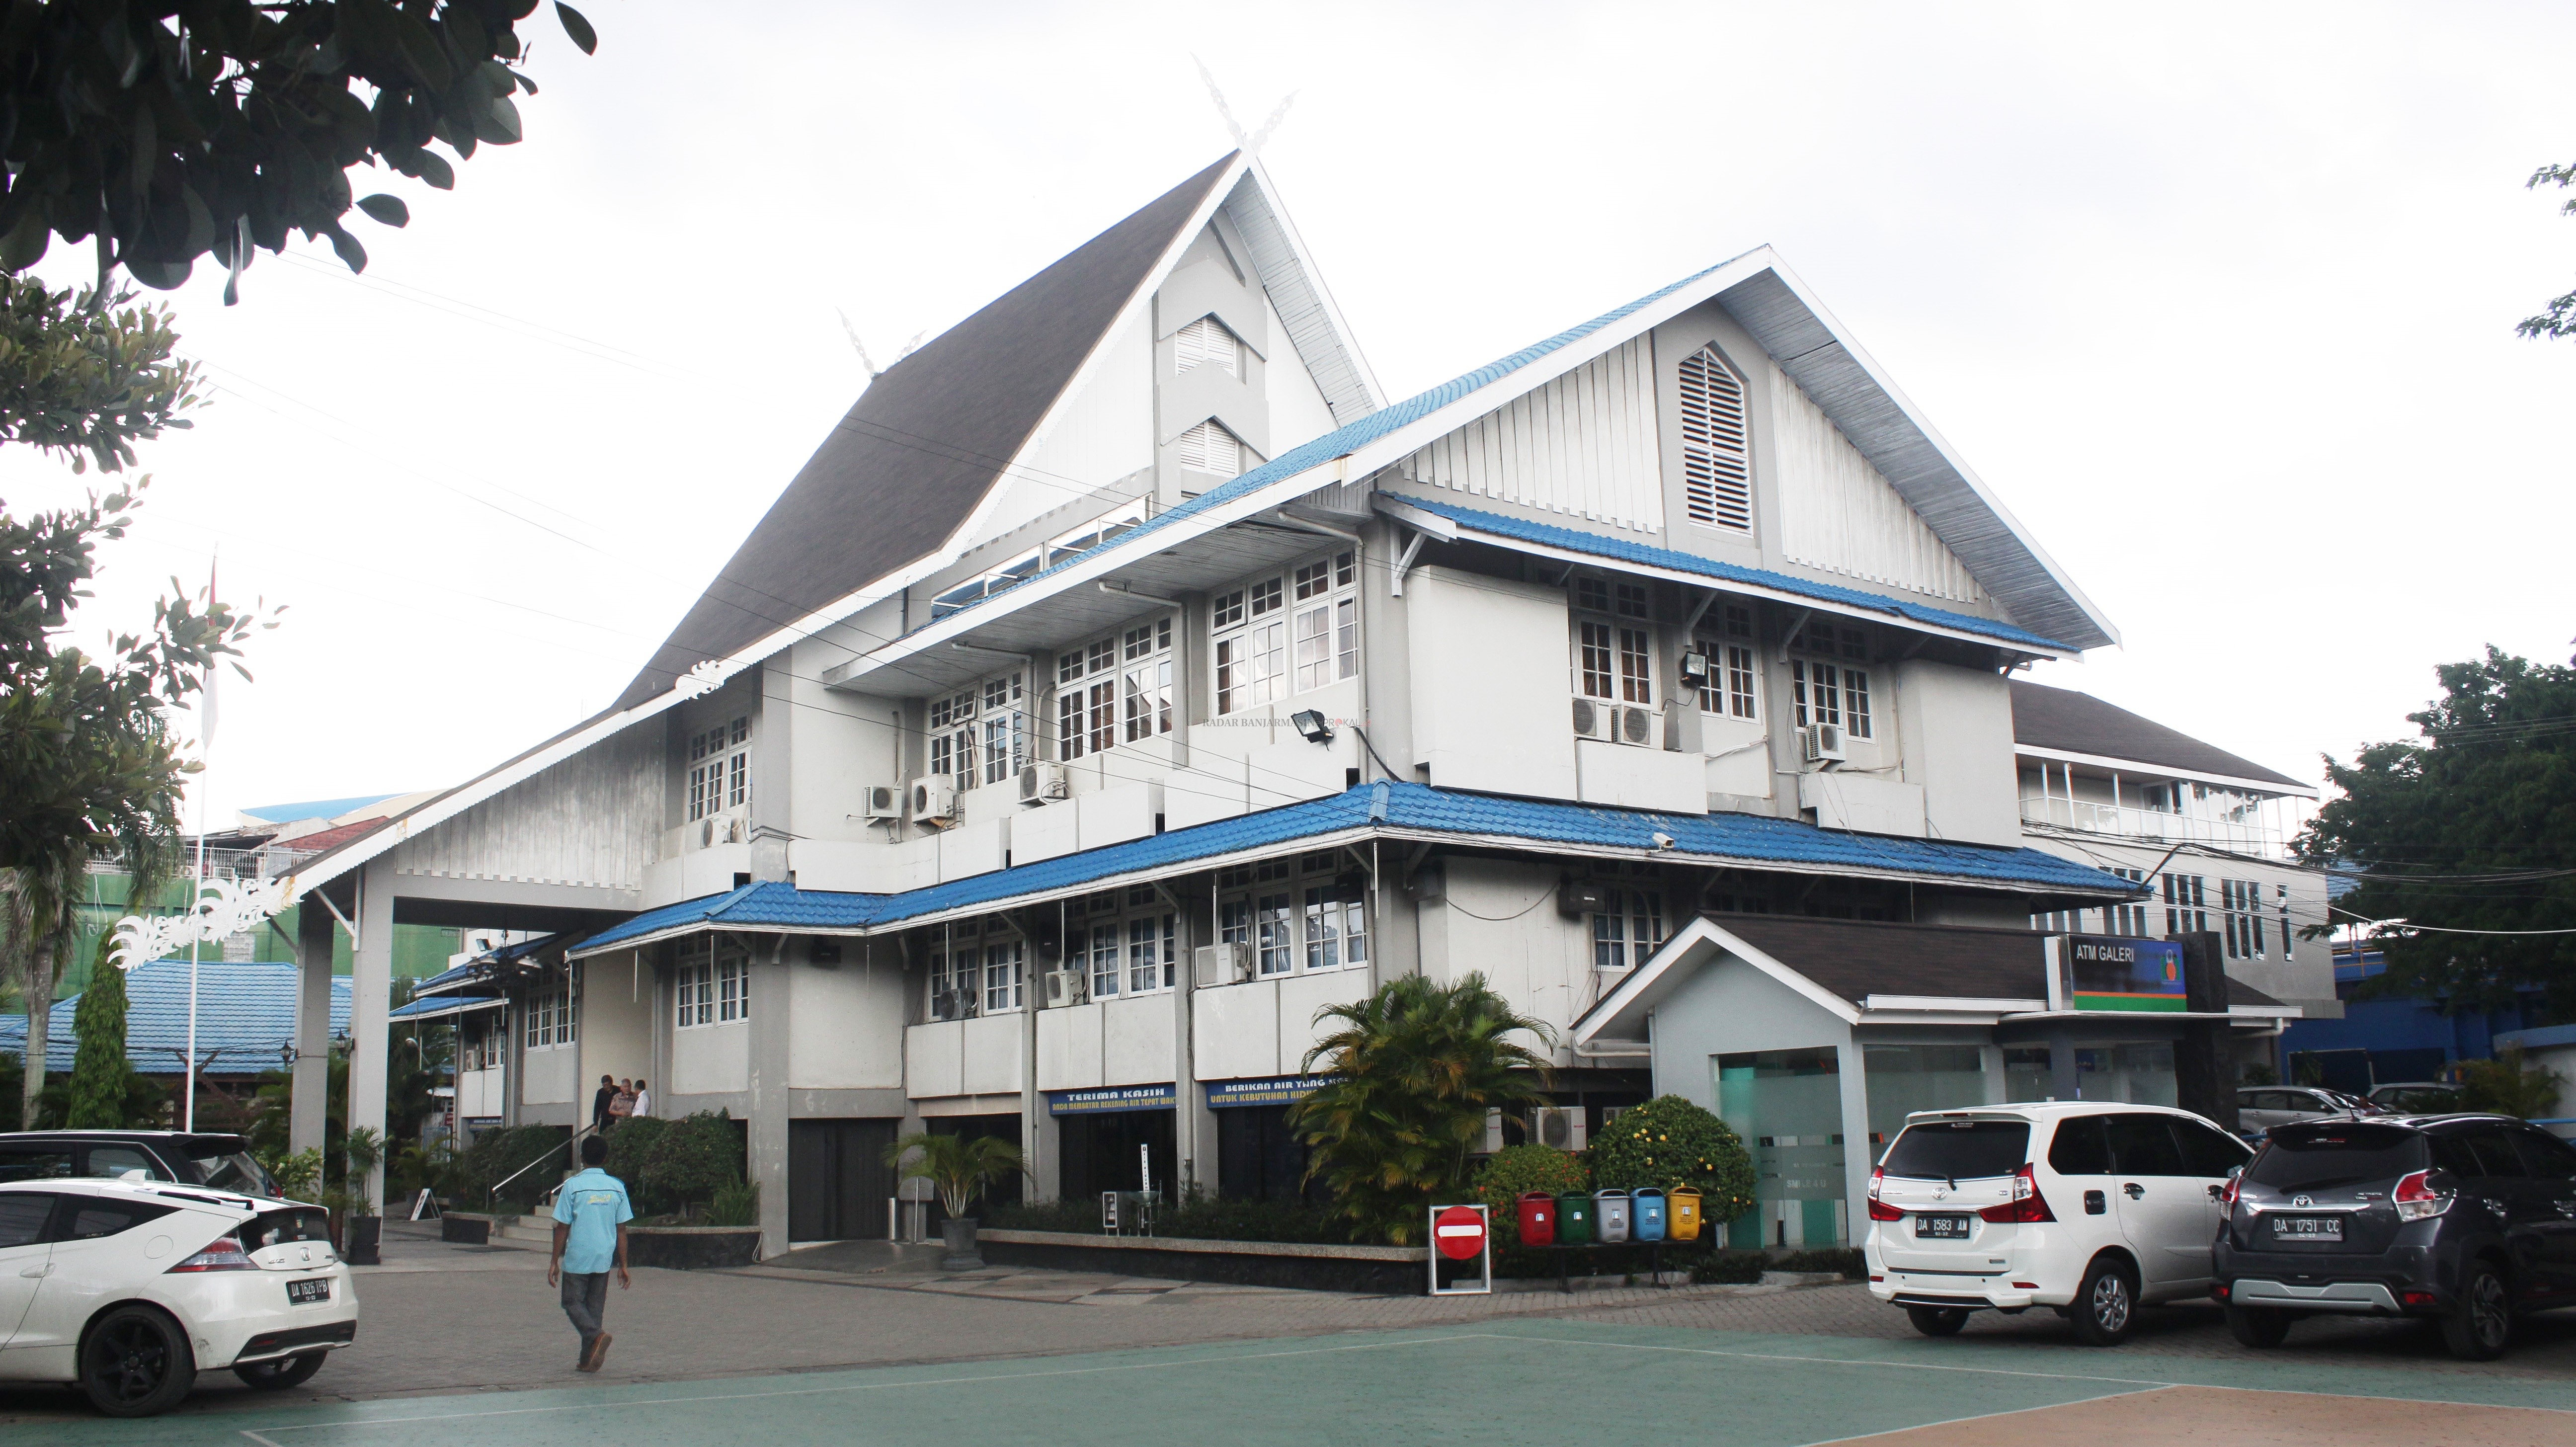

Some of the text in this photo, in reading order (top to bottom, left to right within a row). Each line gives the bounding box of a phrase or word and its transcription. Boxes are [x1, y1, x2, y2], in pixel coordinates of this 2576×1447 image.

[2076, 945, 2134, 963] ATM GALERI
[1225, 1083, 1271, 1092] BERIKAN
[1274, 1081, 1293, 1090] AIR
[1295, 1079, 1325, 1089] YANG
[1067, 1088, 1165, 1101] TERIMA KASIH
[1210, 1095, 1237, 1103] UNTUK
[1239, 1092, 1288, 1102] KEBUTUHAN
[1069, 1101, 1099, 1110] MEMBAYAR
[1101, 1100, 1127, 1109] REKENING
[1140, 1098, 1159, 1106] TEPAT
[1918, 1219, 1928, 1231] DA
[1933, 1219, 1951, 1231] 1583
[2274, 1219, 2339, 1232] DA 1751 CC
[291, 1280, 327, 1297] DA 1626 TPB
